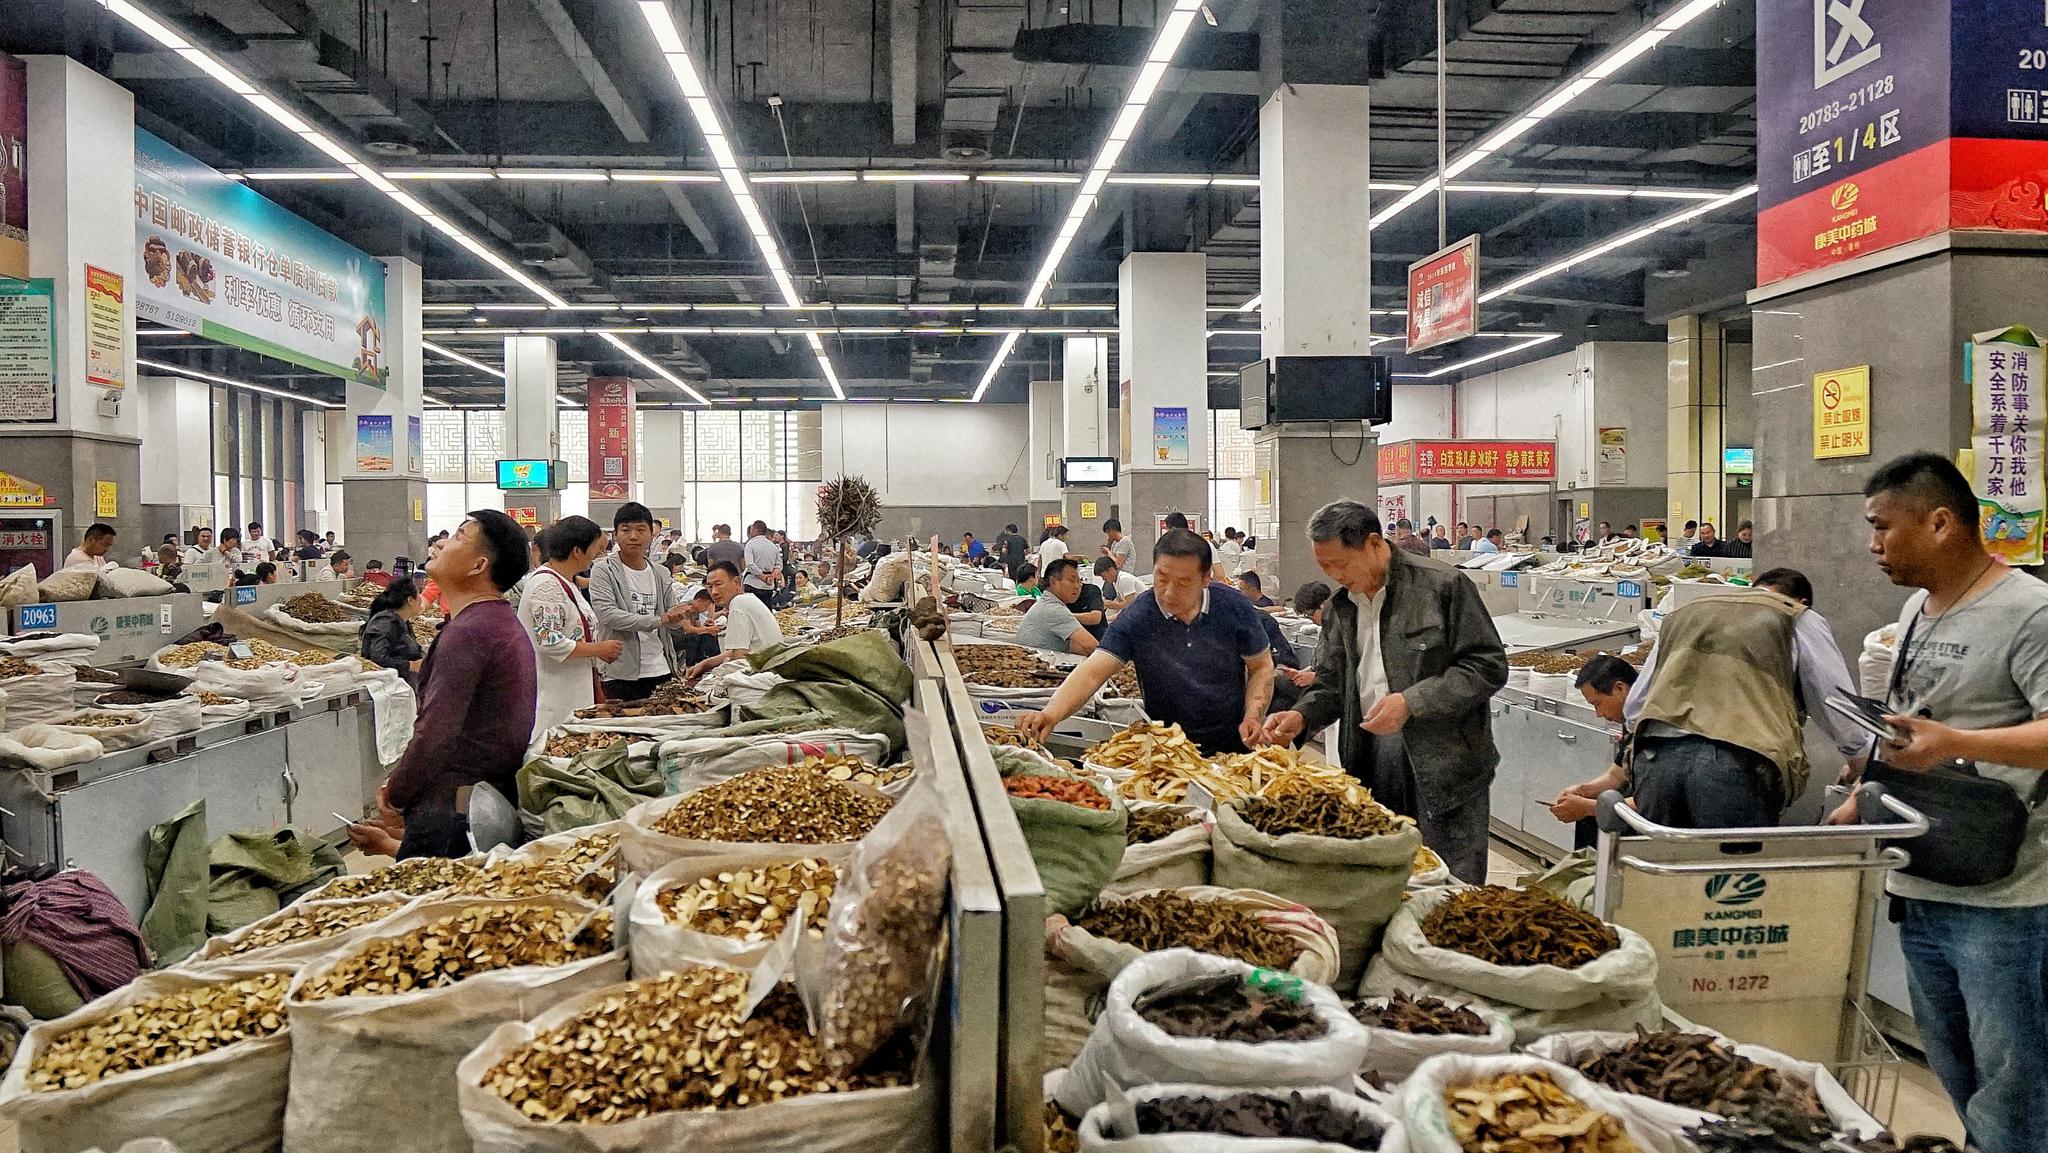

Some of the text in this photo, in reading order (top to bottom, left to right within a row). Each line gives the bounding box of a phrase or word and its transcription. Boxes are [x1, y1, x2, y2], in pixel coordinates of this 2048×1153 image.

[1814, 0, 1881, 89] 区
[1799, 75, 1894, 135] 20783-21128
[134, 184, 338, 303] 中国邮政储蓄银行仓单质押贷款
[1815, 215, 1877, 250] 康美中药城
[165, 310, 197, 328] 5129012
[224, 275, 335, 342] 利率优惠 循环支用
[1987, 351, 2008, 497] 安全系着千万家
[2010, 351, 2028, 497] 消防事关你我他
[1820, 431, 1863, 450] 禁止明火
[3, 533, 44, 546] 消火栓
[22, 607, 55, 626] 20963
[1704, 909, 1762, 921] KANGMEI
[1673, 925, 1789, 949] 康美中药城
[1728, 975, 1769, 990] 1272
